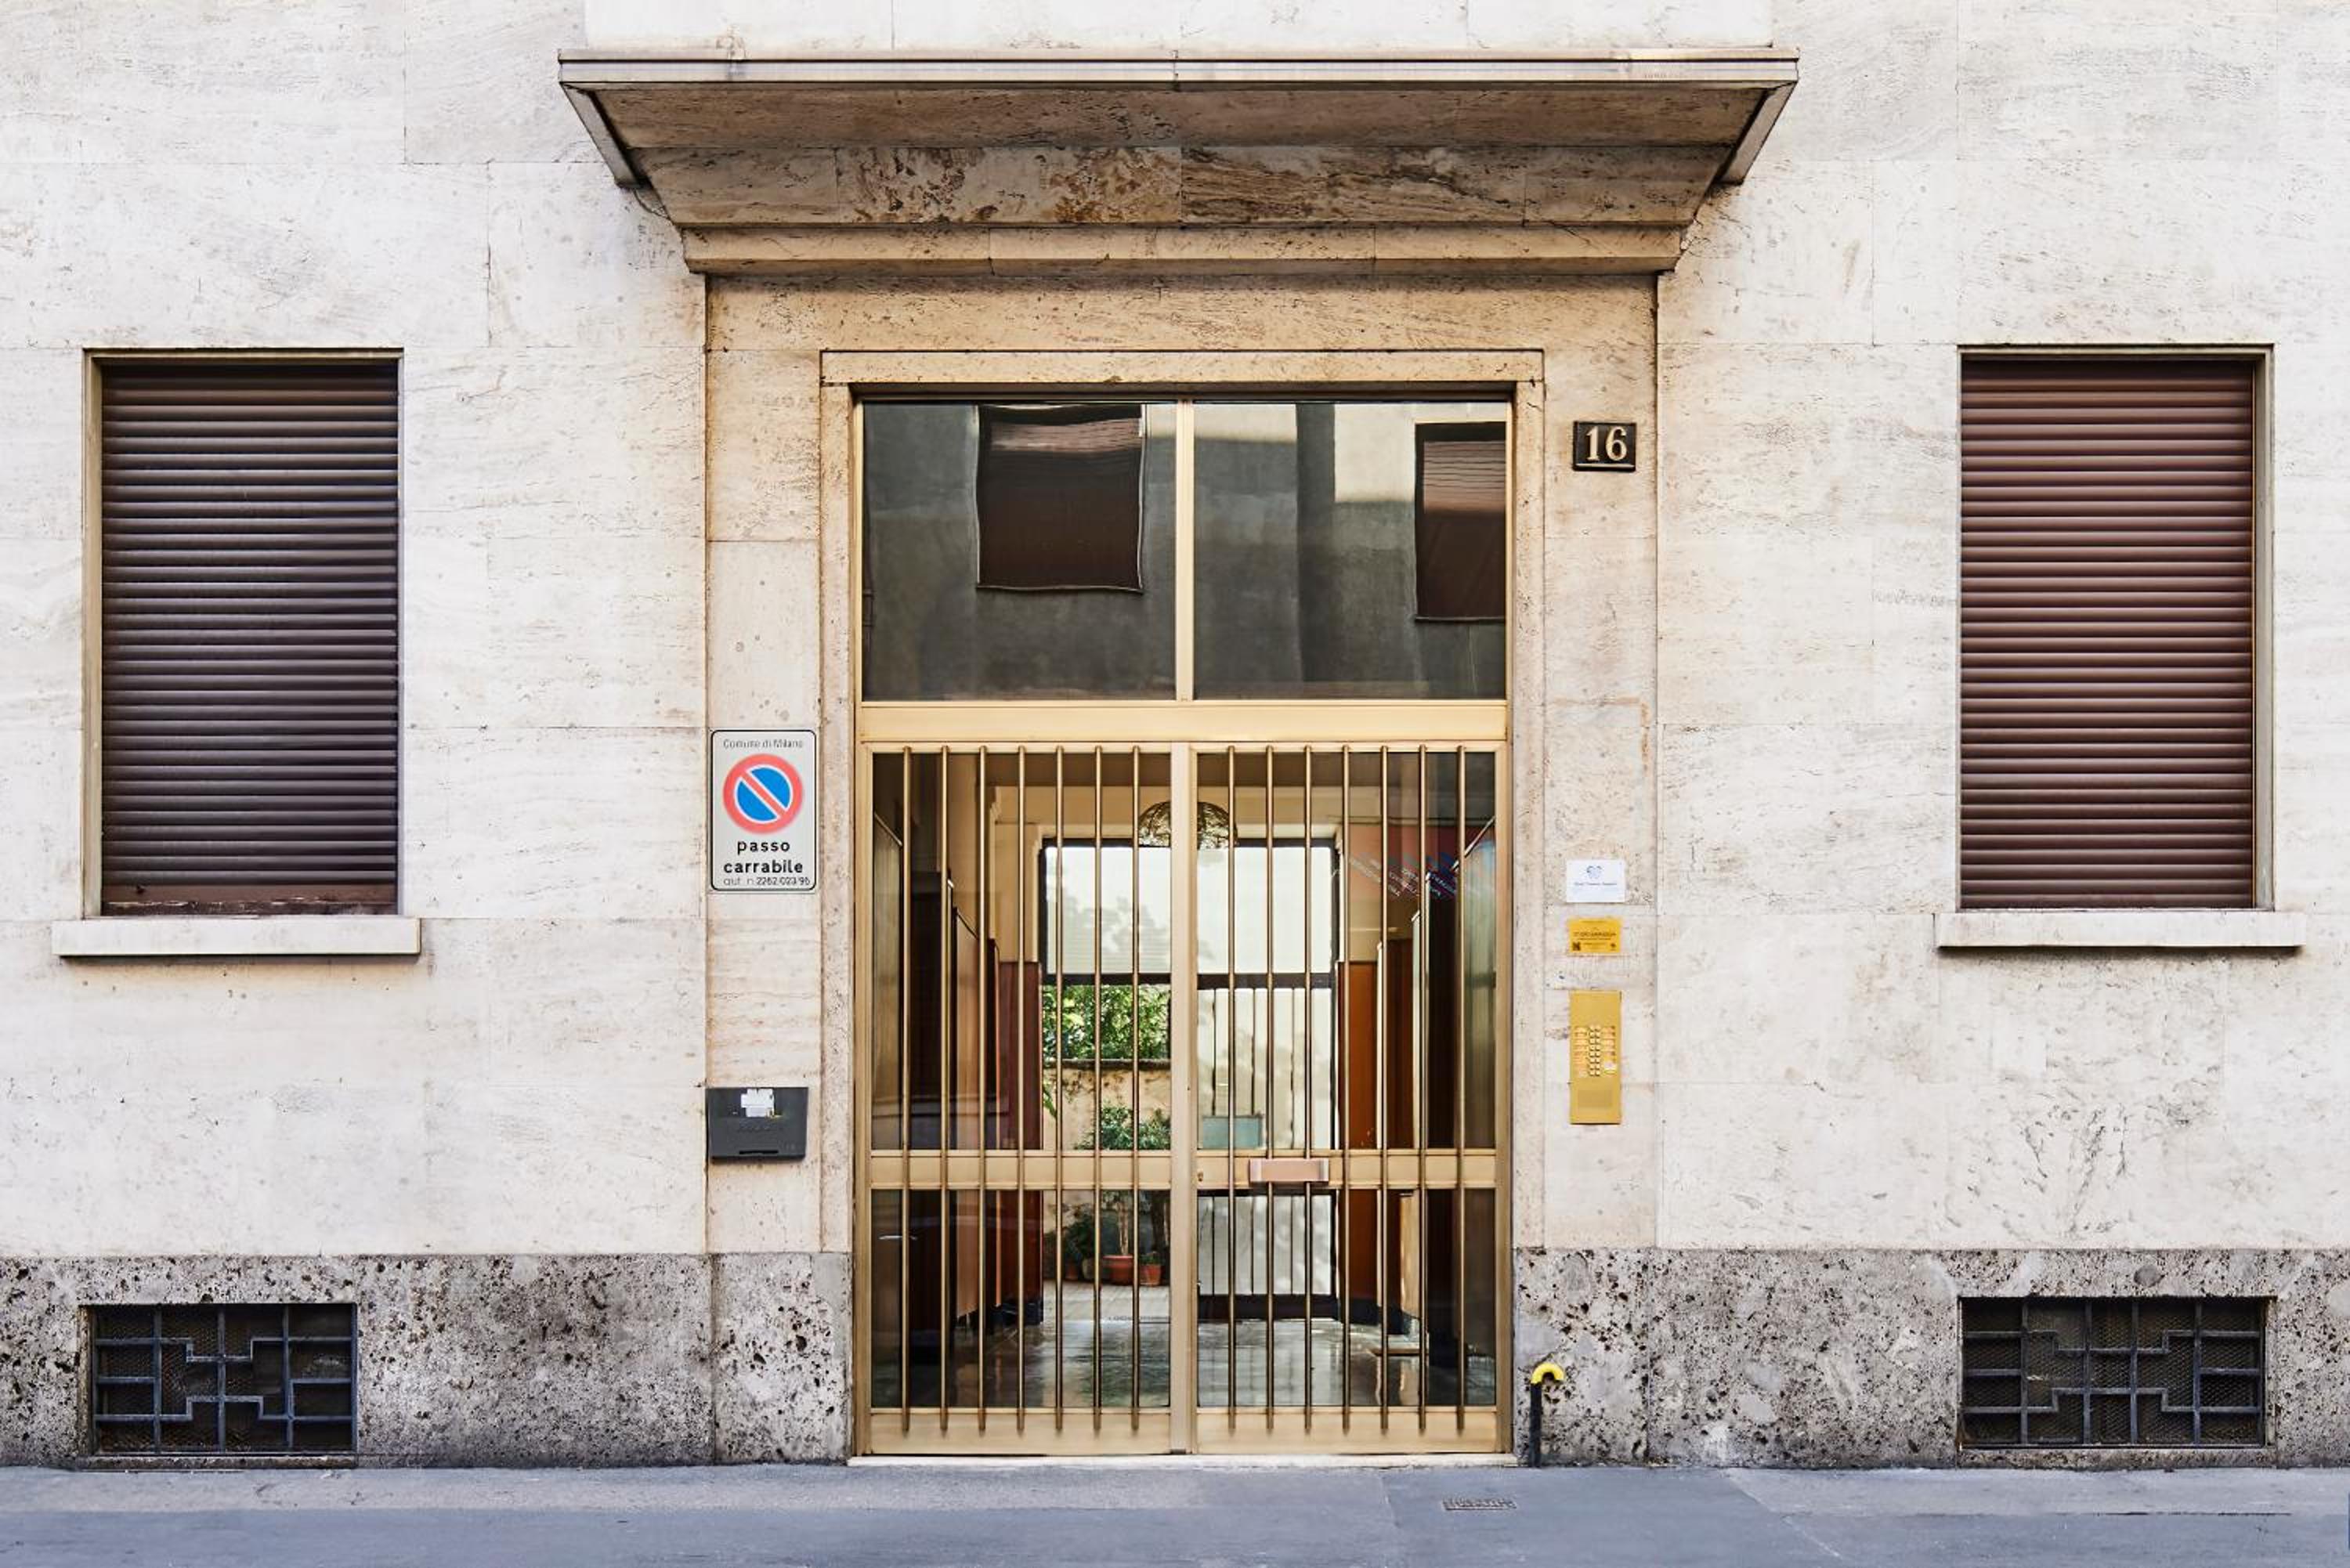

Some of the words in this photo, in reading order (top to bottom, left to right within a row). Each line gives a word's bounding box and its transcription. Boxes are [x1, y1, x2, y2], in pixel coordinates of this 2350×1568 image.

[1585, 426, 1627, 461] 16
[723, 739, 761, 749] Comune
[762, 739, 772, 748] di
[773, 739, 803, 748] Milano
[737, 840, 790, 855] passo
[723, 859, 803, 873] carrabile
